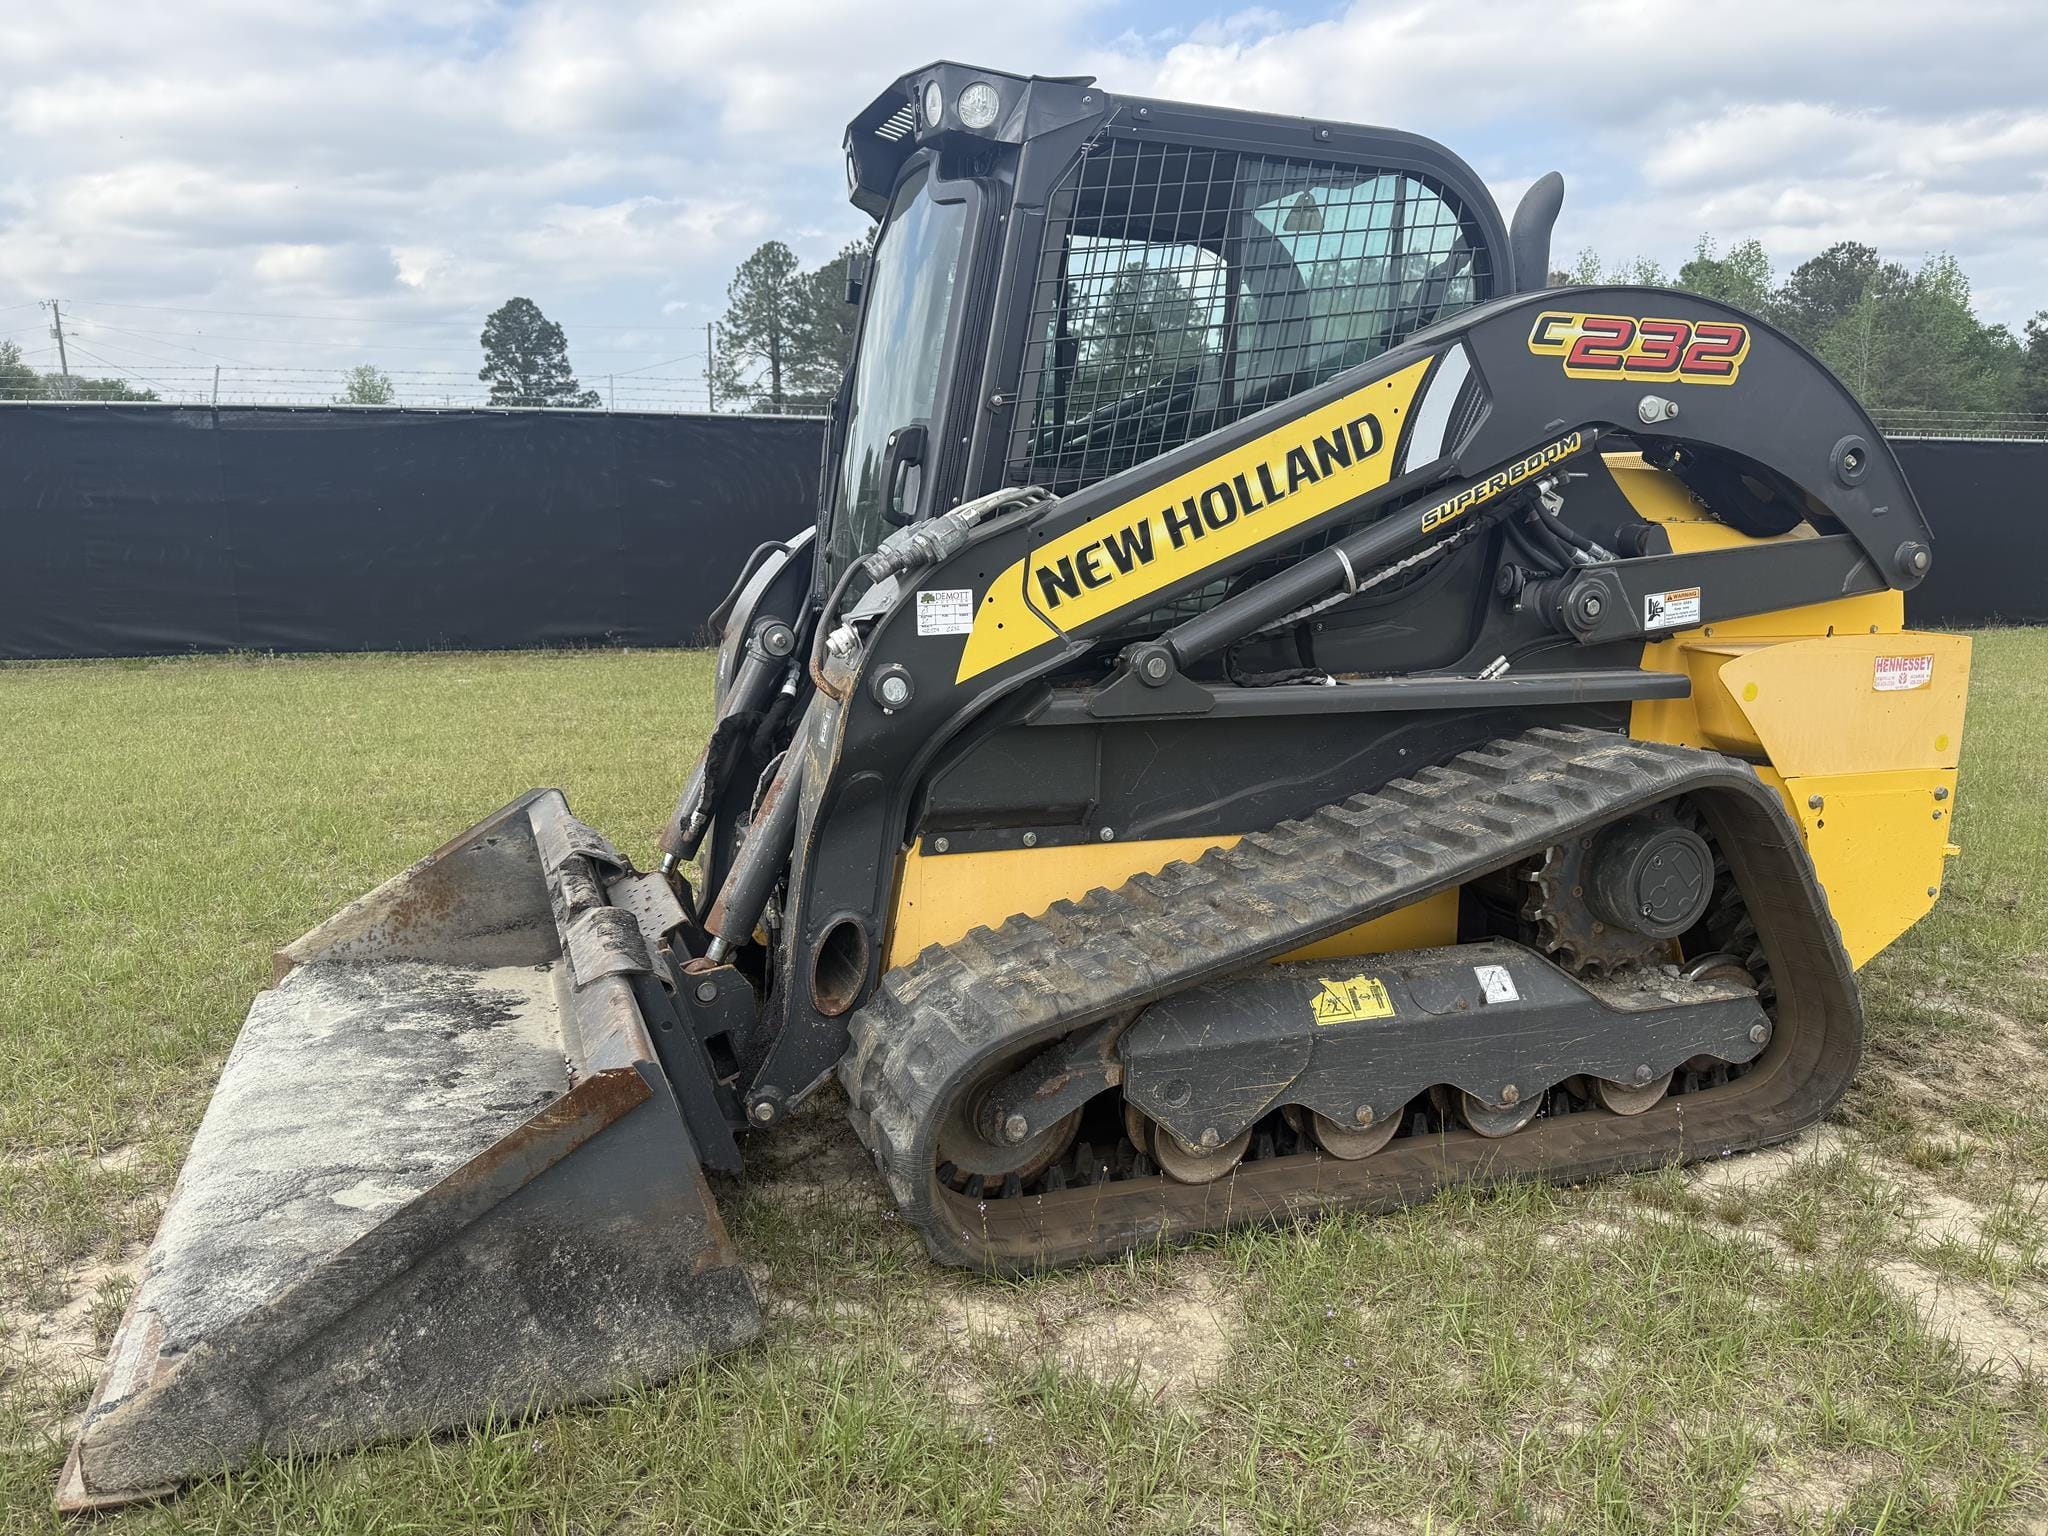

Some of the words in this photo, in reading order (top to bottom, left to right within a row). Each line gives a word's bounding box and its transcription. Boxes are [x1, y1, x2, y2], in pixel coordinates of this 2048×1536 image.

[1529, 312, 1749, 384] C232
[1422, 473, 1507, 533] SUPER
[1509, 432, 1582, 486] BOOM
[1034, 517, 1155, 611] NEW
[1162, 412, 1384, 550] HOLLAND
[935, 591, 969, 600] DEMOTT
[1673, 591, 1696, 599] WARNING
[1876, 656, 1931, 672] HENNESSEY
